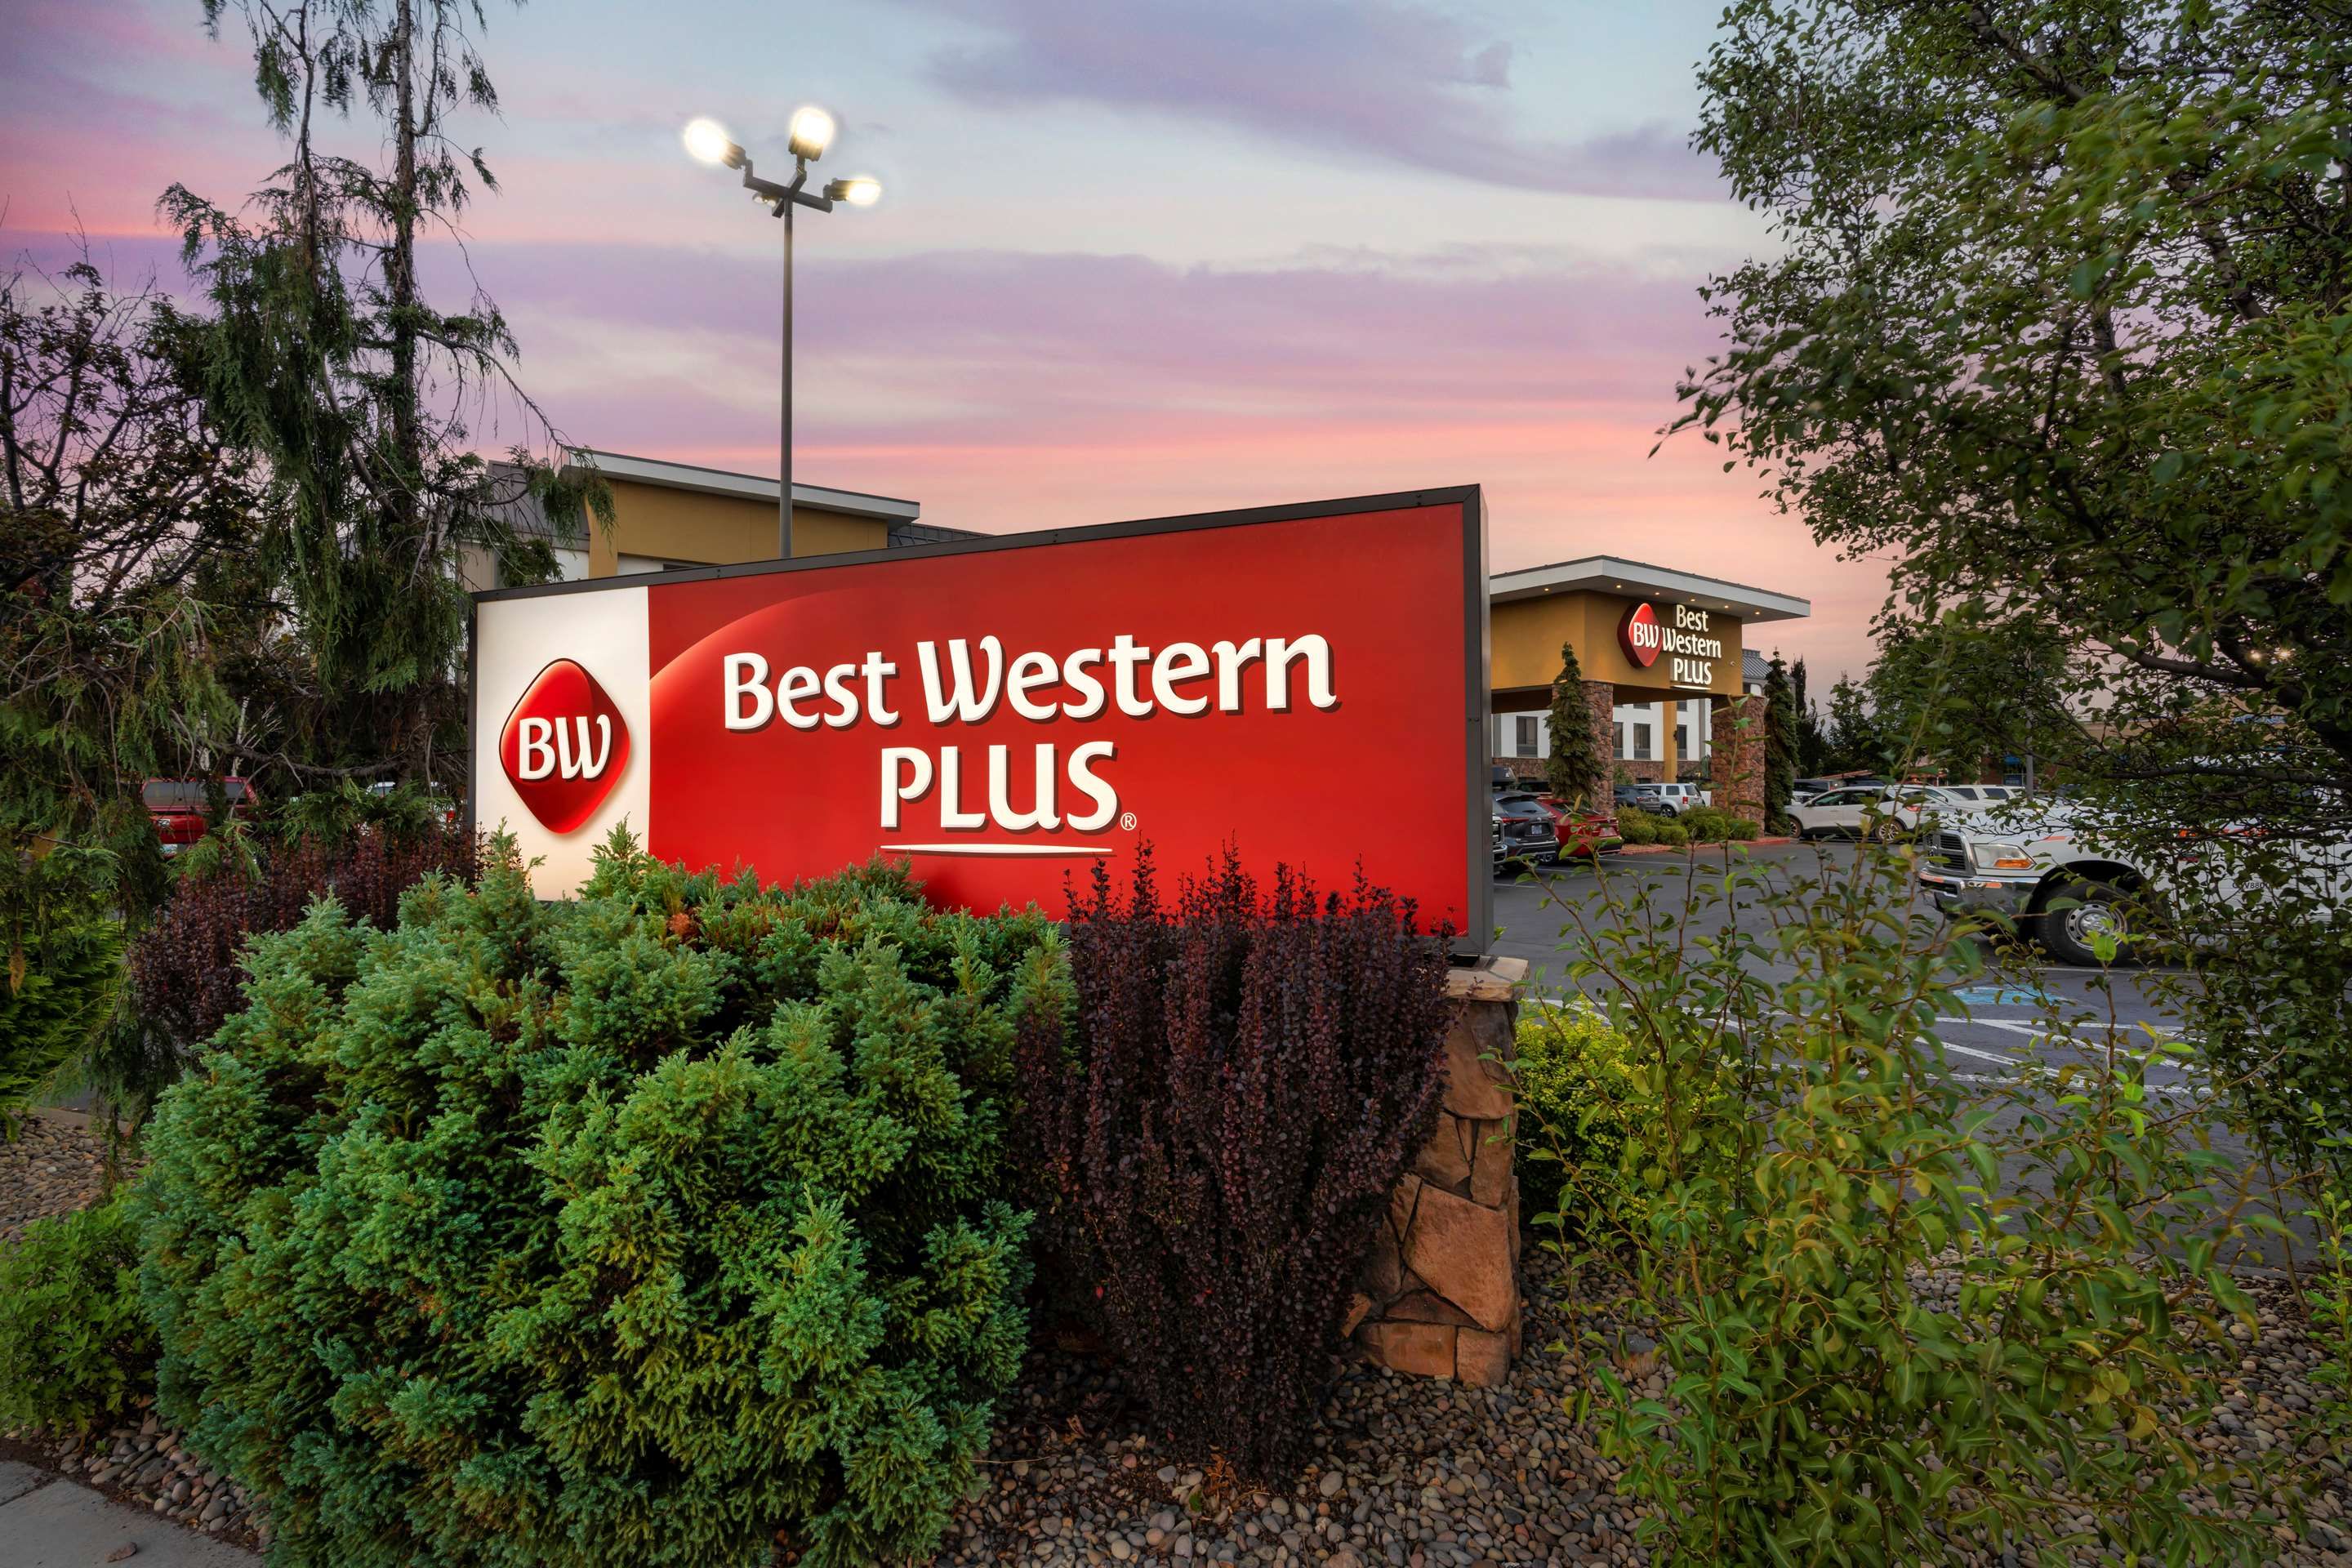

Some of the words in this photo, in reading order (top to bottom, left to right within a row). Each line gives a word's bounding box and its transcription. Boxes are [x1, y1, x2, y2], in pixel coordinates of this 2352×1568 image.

[1676, 604, 1709, 632] Best
[1633, 621, 1659, 648] BW
[1661, 626, 1722, 658] Western
[724, 651, 899, 730] Best
[916, 634, 1337, 724] Western
[1673, 657, 1713, 685] PLUS
[518, 714, 611, 781] BW
